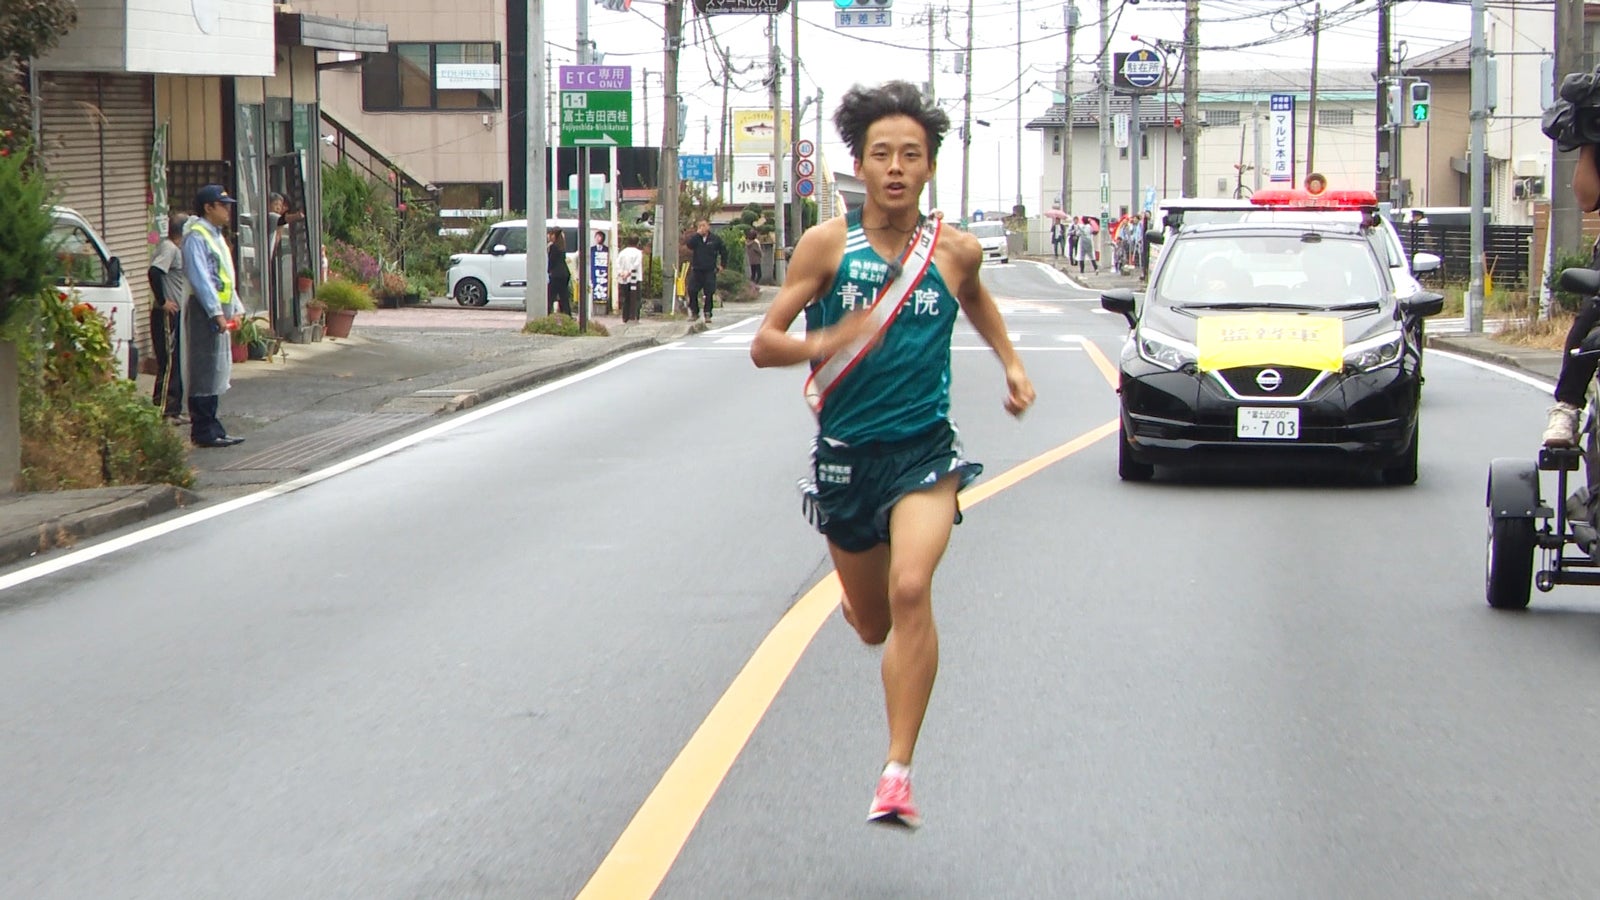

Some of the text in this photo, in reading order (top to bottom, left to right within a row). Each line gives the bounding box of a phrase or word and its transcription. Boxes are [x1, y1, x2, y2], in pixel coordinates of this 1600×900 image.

[840, 13, 886, 25] 時差式
[1127, 62, 1159, 73] 駐在所
[566, 68, 624, 84] ETC 専用
[599, 80, 623, 88] ONLY
[565, 94, 585, 107] 1-1
[563, 109, 628, 123] 富士吉田西桂
[1275, 115, 1286, 171] マルビ本店
